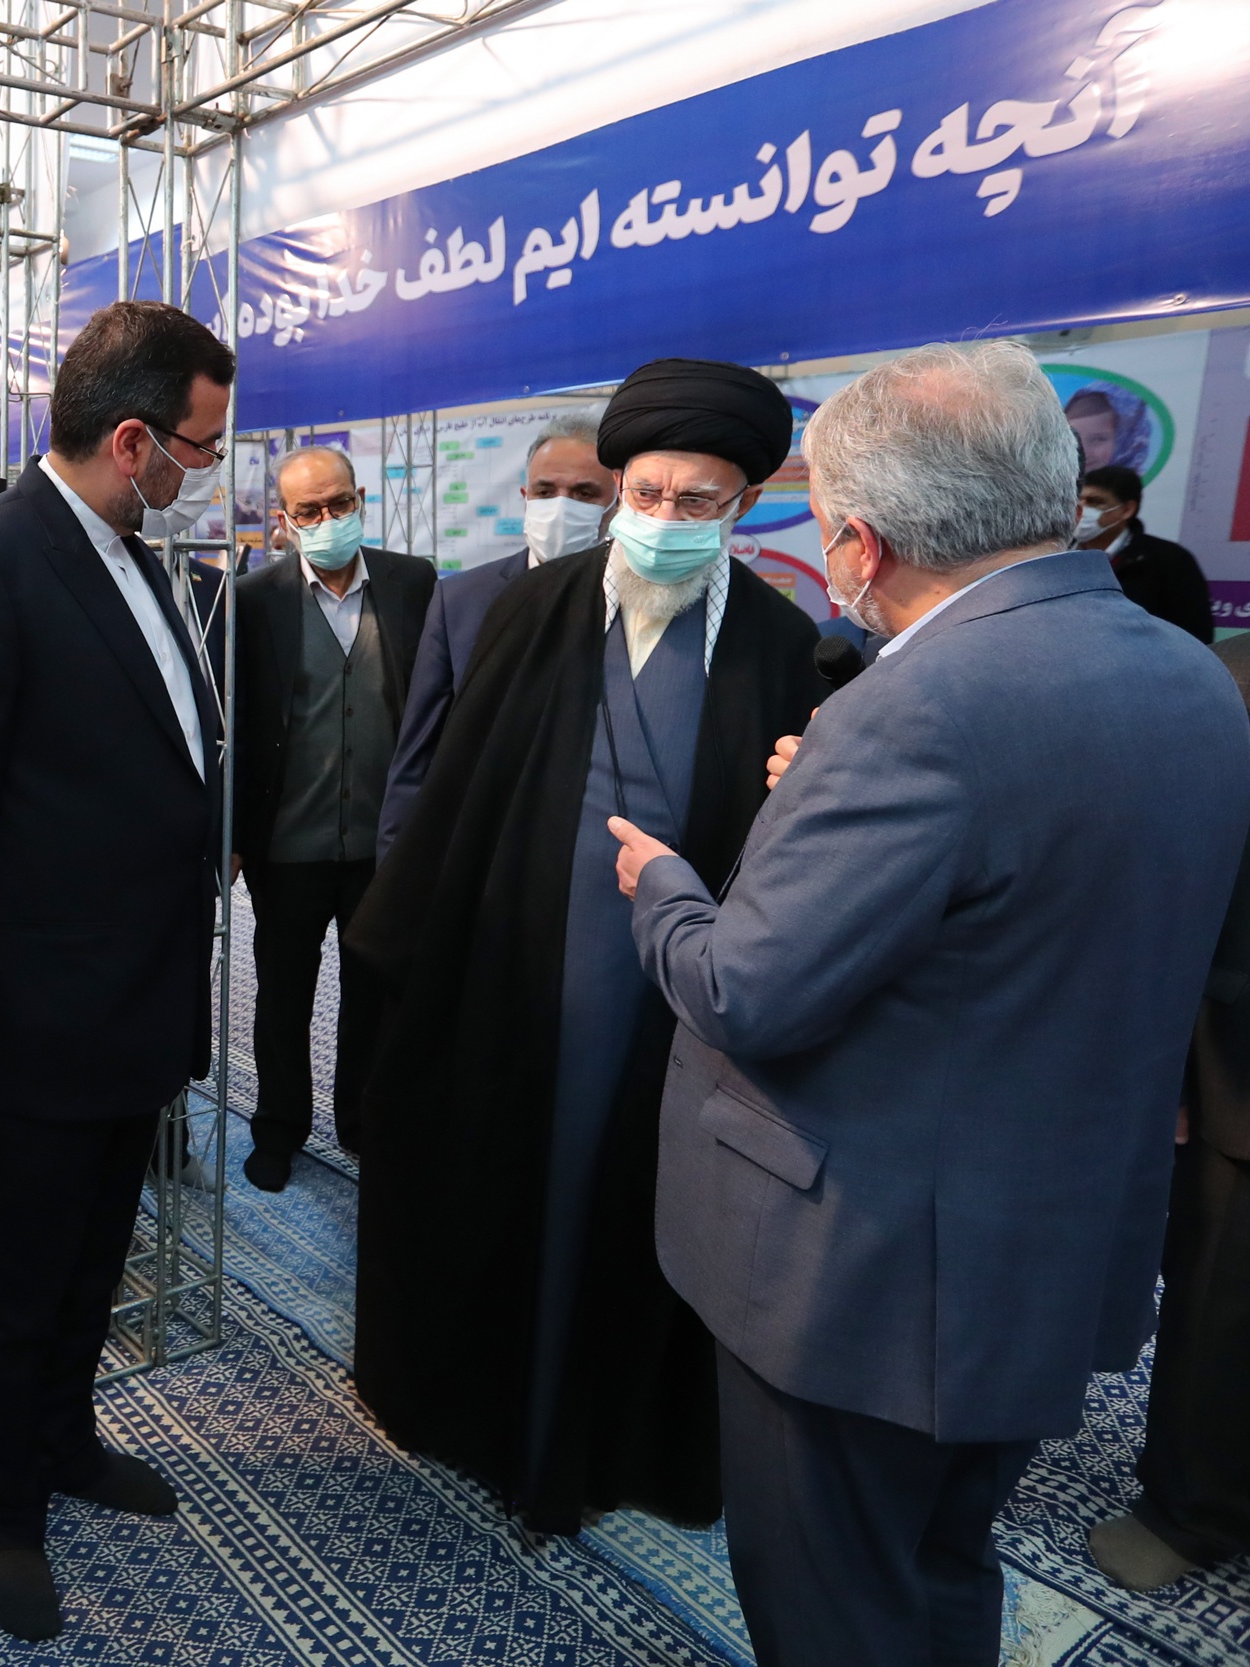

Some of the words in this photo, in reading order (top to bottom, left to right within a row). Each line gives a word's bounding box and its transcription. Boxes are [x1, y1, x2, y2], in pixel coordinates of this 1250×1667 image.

[911, 1, 1161, 218] آنچه
[610, 108, 902, 249] توانسته
[395, 215, 506, 300] لطف
[513, 188, 600, 306] ایم
[237, 285, 311, 347] بوده
[316, 249, 388, 319] خدا
[454, 420, 469, 431] خلیج
[477, 414, 488, 428] آب
[489, 416, 507, 428] انتقال
